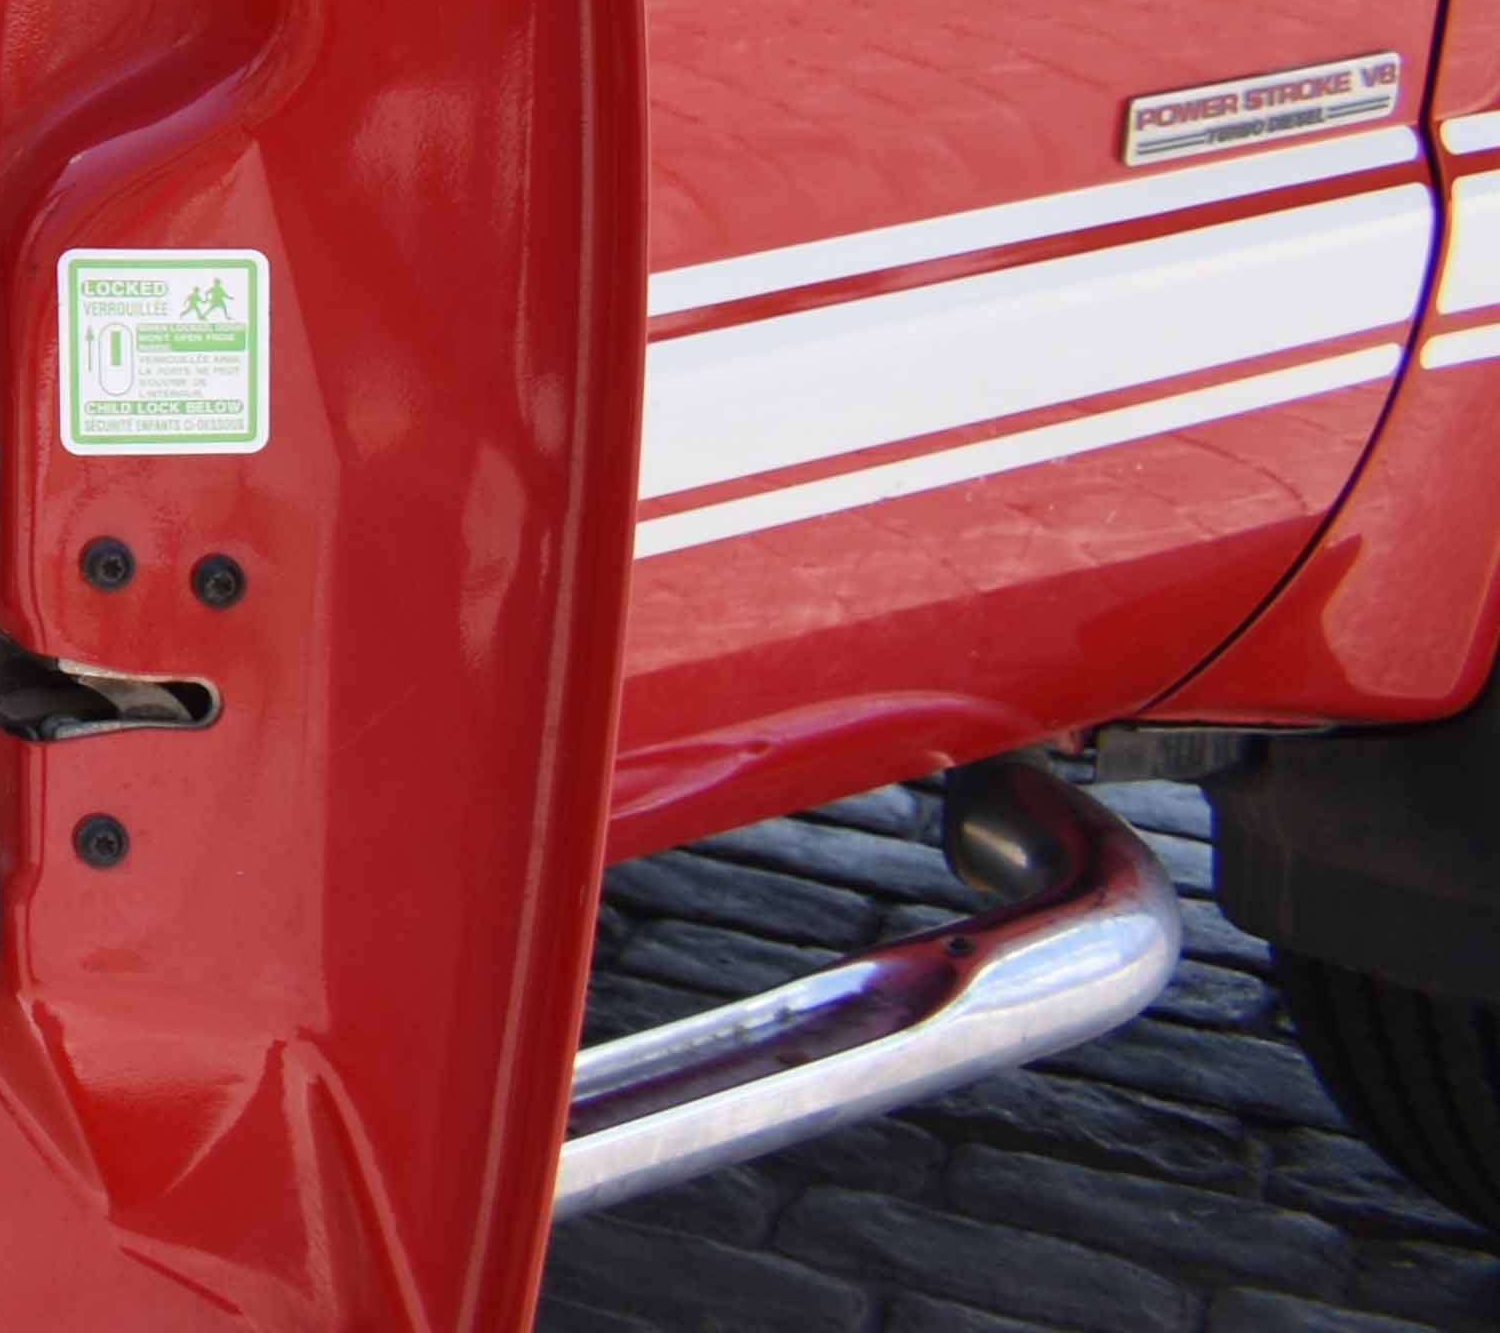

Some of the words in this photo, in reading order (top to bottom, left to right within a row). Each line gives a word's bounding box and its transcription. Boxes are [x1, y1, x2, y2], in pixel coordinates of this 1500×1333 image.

[1136, 94, 1238, 131] POWER
[1243, 71, 1353, 111] STROKE
[83, 281, 167, 297] LOCKED
[86, 402, 131, 414] CHILD
[137, 402, 181, 414] LOCK
[186, 401, 242, 413] BELOW
